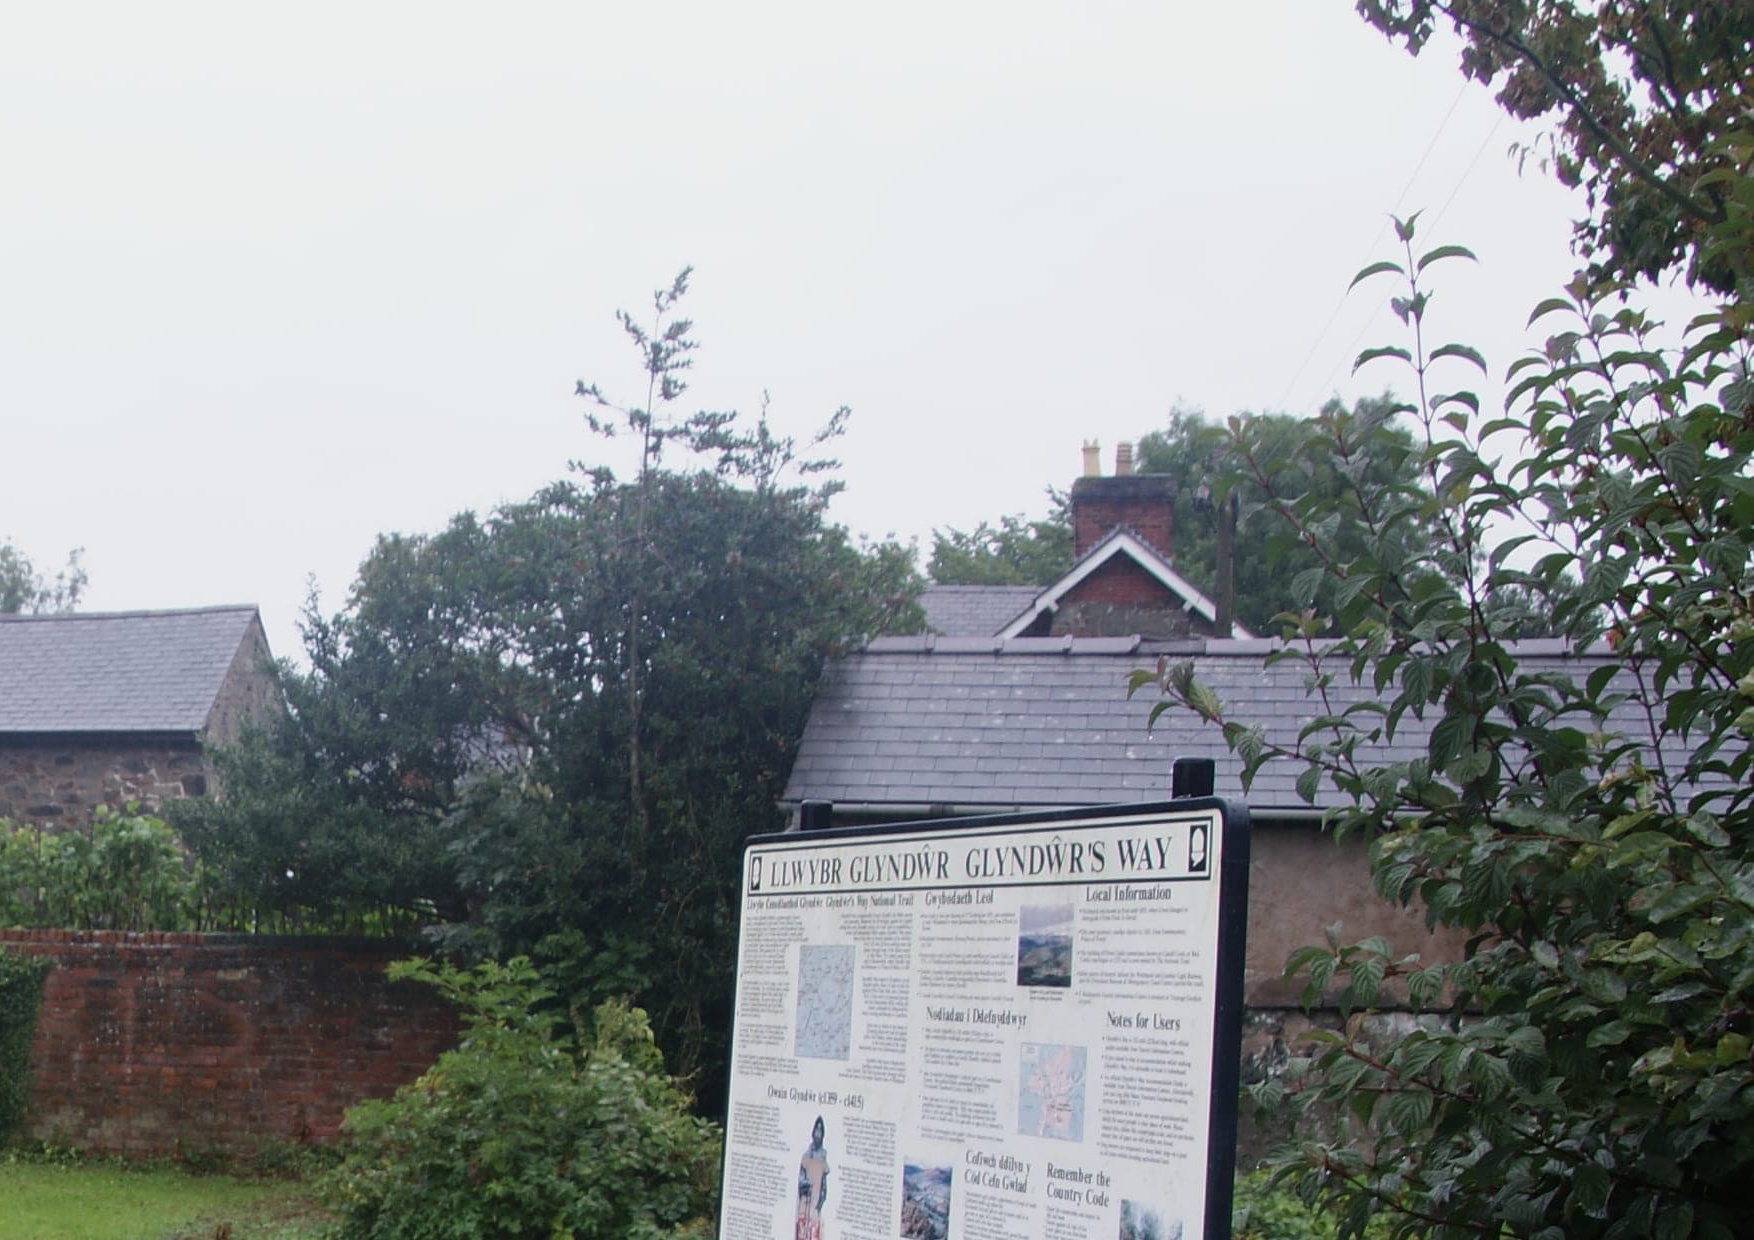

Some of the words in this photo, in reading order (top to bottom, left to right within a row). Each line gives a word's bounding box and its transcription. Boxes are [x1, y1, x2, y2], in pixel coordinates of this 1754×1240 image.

[770, 856, 843, 887] LLWYBR
[1117, 836, 1173, 873] WAY
[975, 889, 995, 905] Leol
[1086, 886, 1112, 902] Local
[1114, 884, 1172, 901] Information
[1107, 1011, 1133, 1029] Notes
[1135, 1012, 1149, 1030] for
[1153, 1013, 1181, 1032] Users
[767, 1084, 788, 1100] Owain
[998, 1154, 1024, 1176] ddilyn
[1046, 1162, 1094, 1184] Remember
[1096, 1170, 1111, 1188] the
[1001, 1175, 1028, 1194] Gwlad
[1046, 1182, 1084, 1207] Country
[1085, 1188, 1110, 1208] Code
